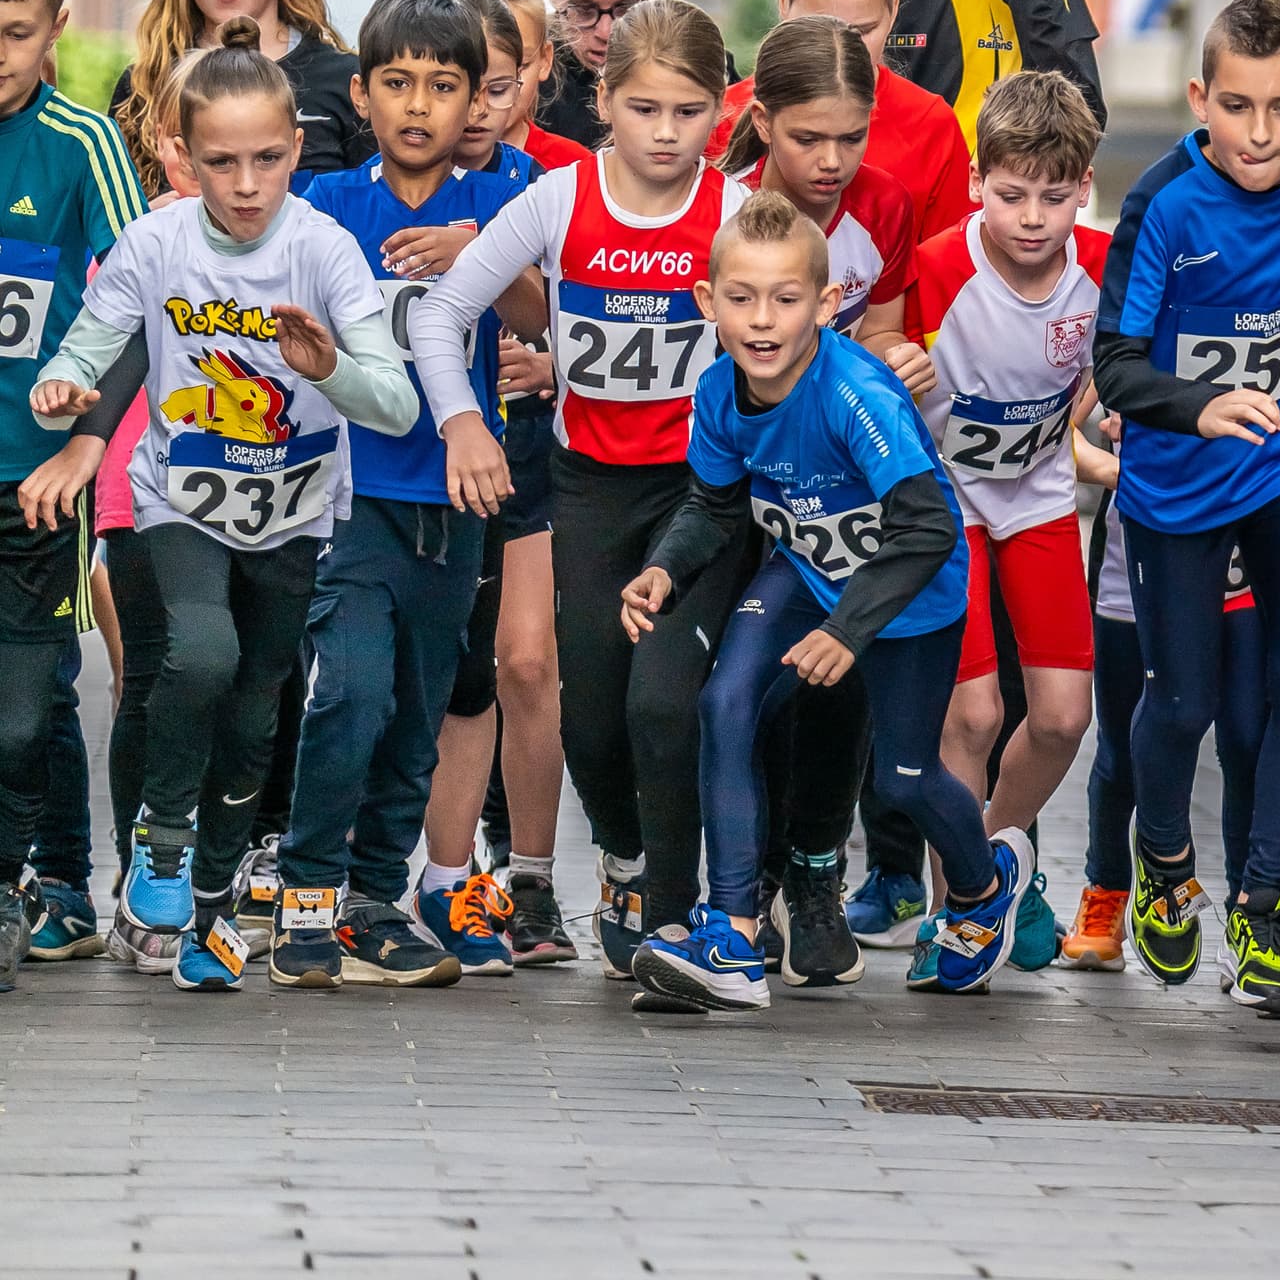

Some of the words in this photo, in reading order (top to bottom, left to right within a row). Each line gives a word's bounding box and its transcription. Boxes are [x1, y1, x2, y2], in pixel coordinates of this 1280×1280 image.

[587, 247, 694, 276] ACW'66
[605, 294, 655, 306] LOPERS
[605, 304, 655, 315] COMPANY
[633, 315, 668, 324] TILBURG
[1235, 319, 1280, 332] COMPANY
[567, 320, 706, 391] 247
[1004, 401, 1050, 413] LOPERS
[951, 400, 1075, 472] 244
[225, 443, 274, 459] LOPERS
[224, 454, 273, 468] COMPANY
[253, 463, 286, 474] TILBURG
[182, 460, 323, 537] 237
[762, 507, 885, 573] 226
[297, 892, 322, 901] 306
[961, 924, 983, 935] 226
